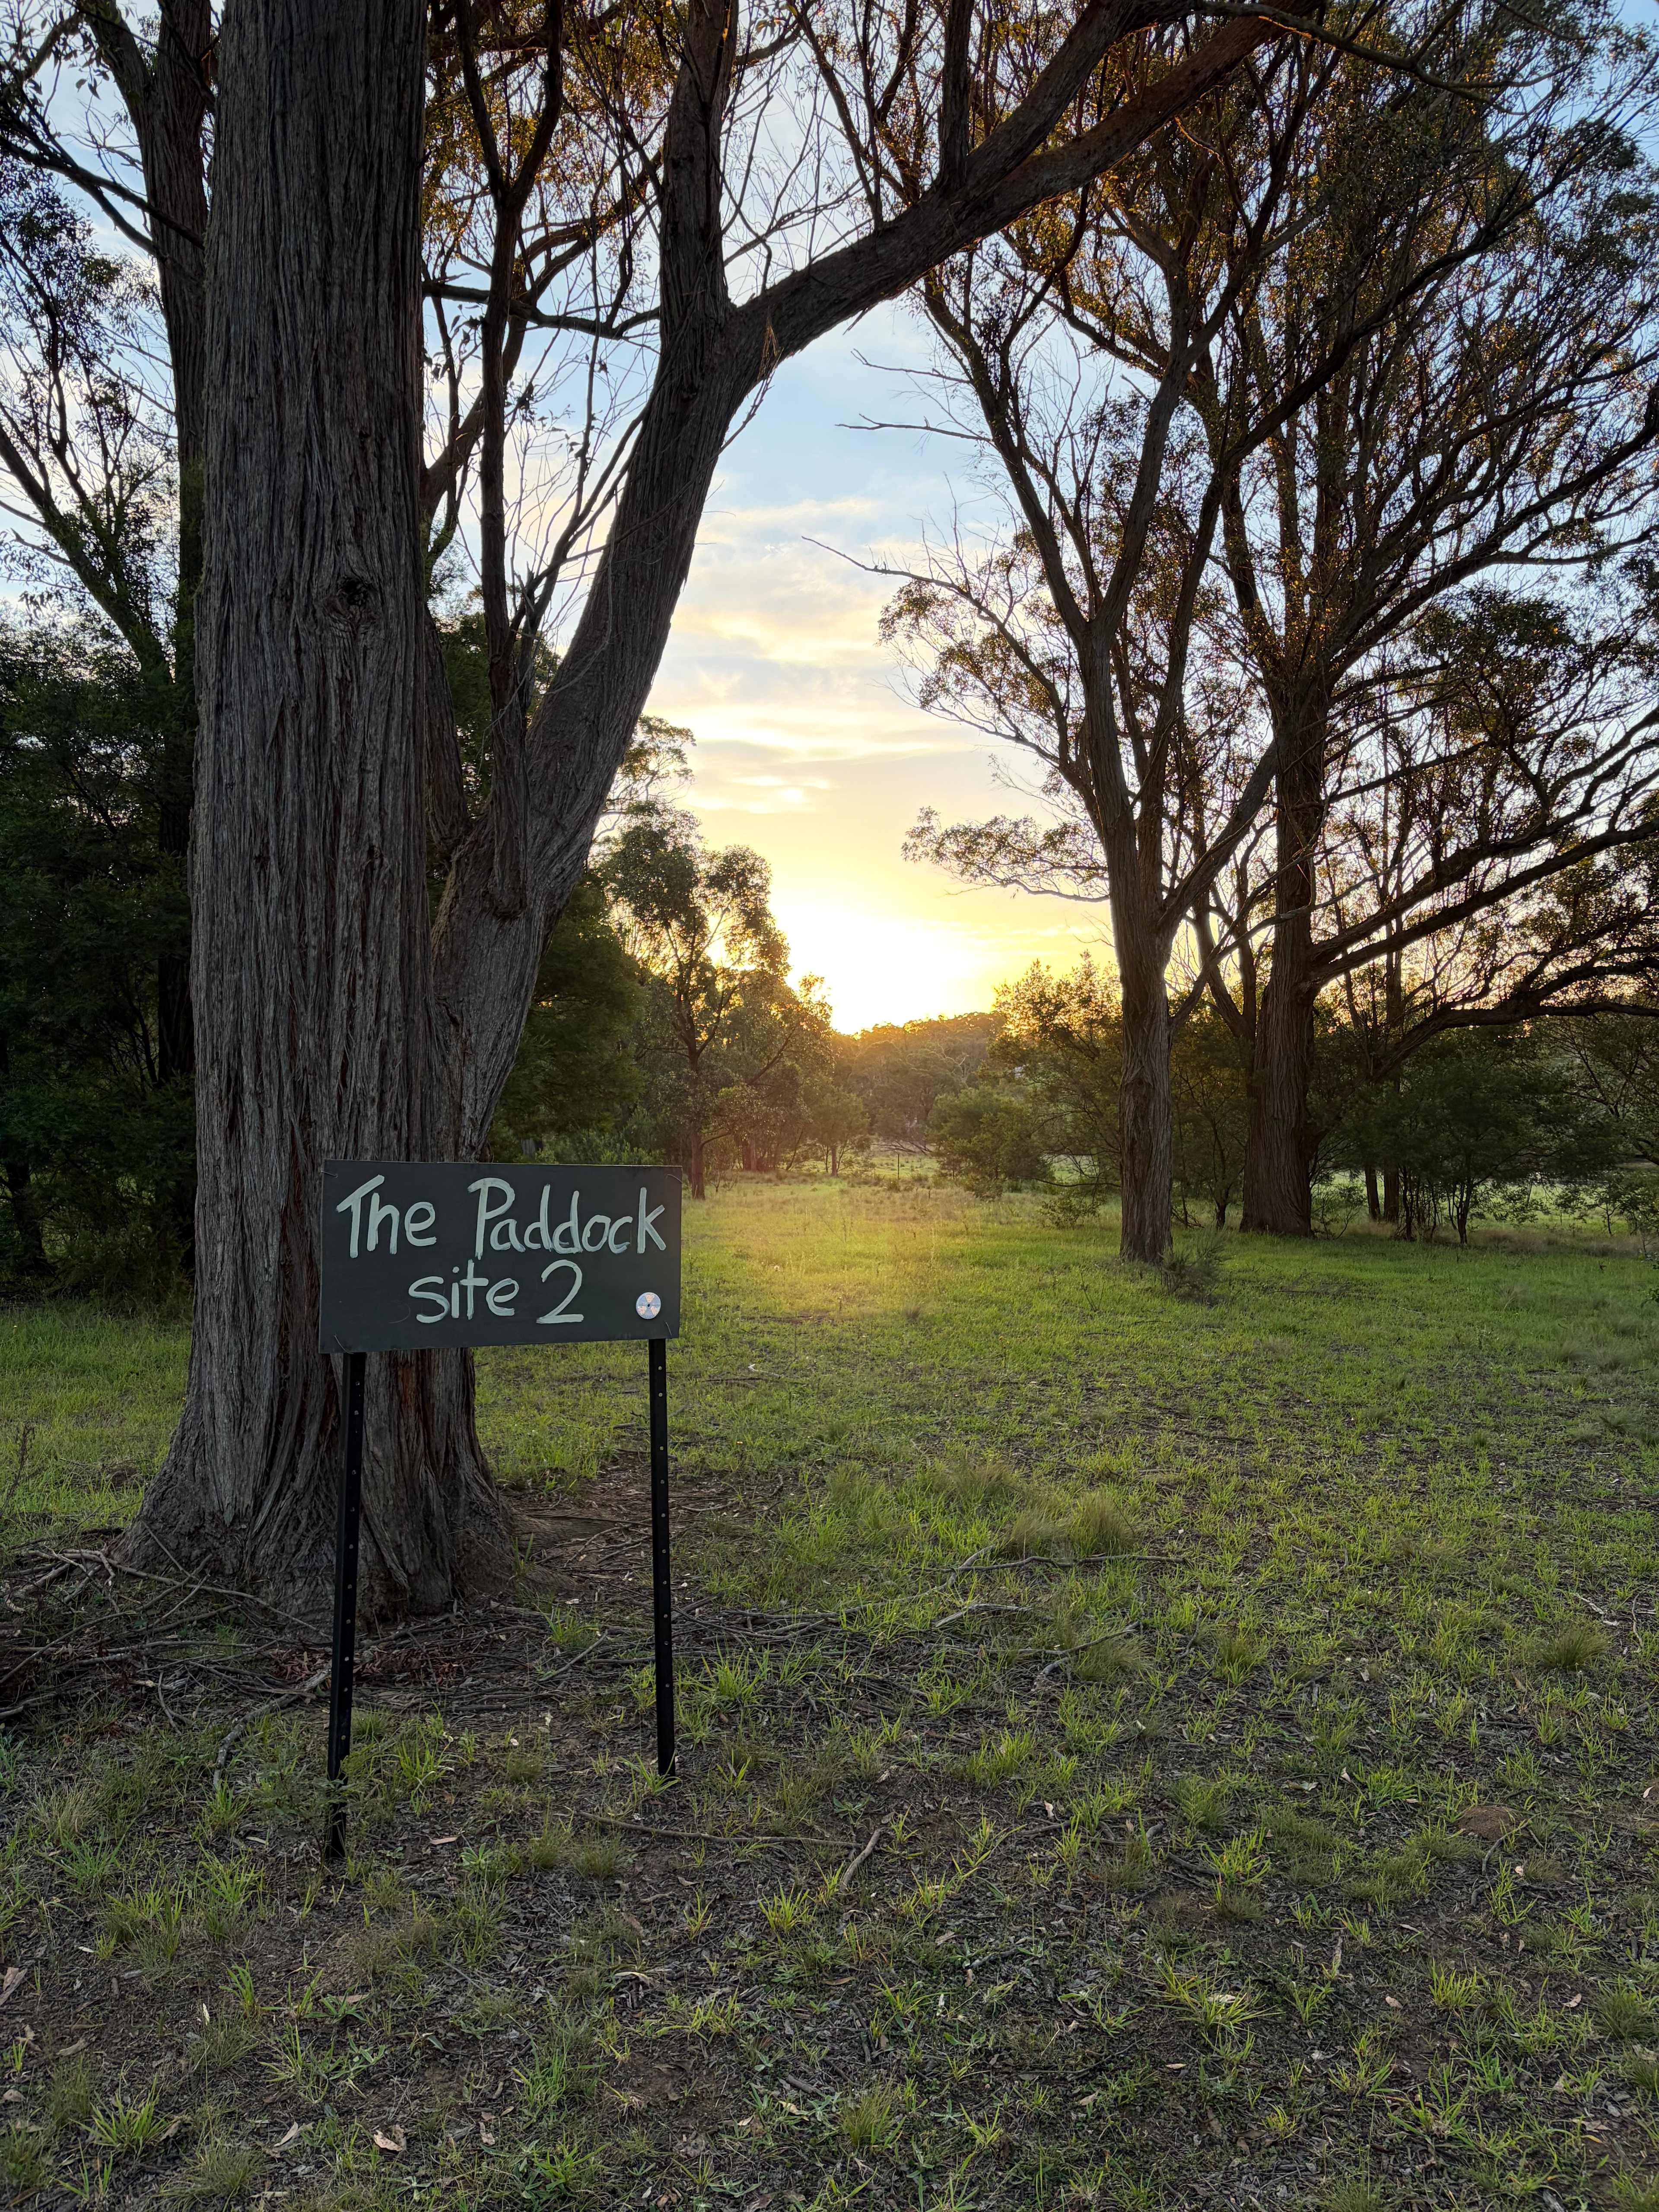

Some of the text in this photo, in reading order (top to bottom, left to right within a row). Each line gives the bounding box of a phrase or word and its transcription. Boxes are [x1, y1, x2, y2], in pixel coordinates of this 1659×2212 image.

[337, 1174, 666, 1260] The Paddock
[408, 1259, 585, 1324] site 2
